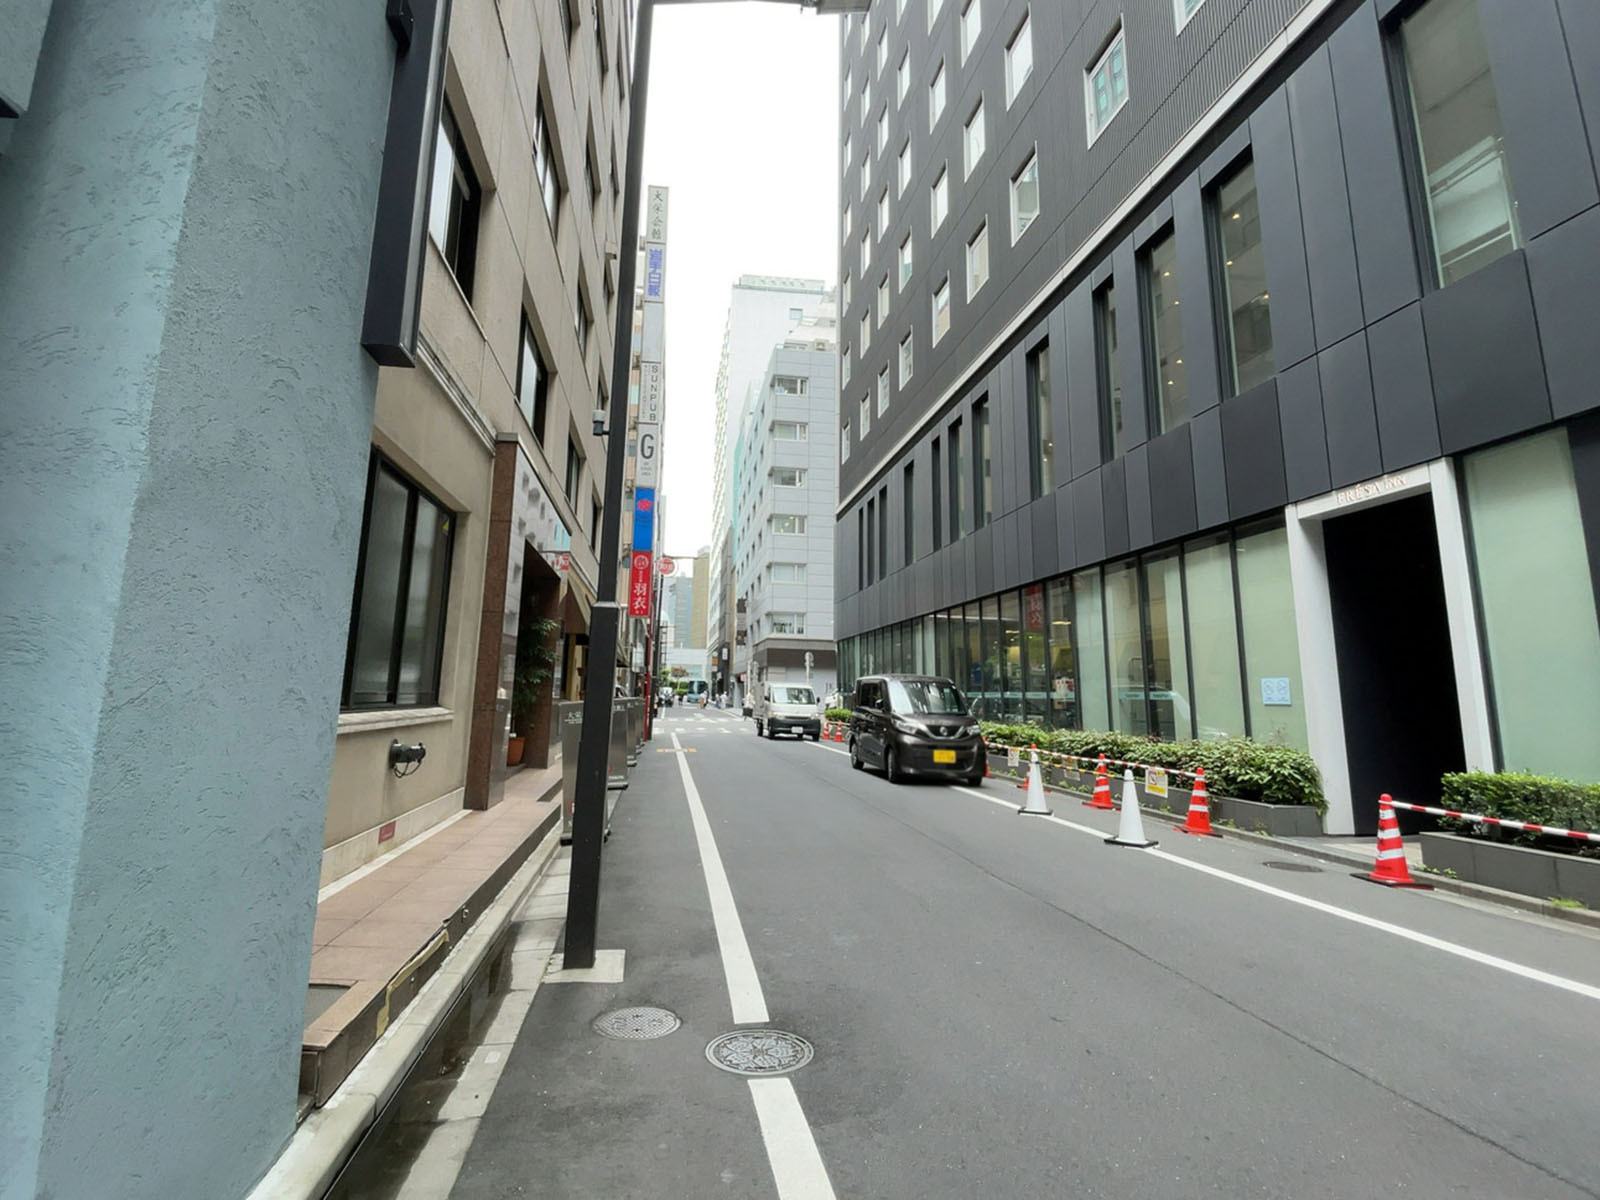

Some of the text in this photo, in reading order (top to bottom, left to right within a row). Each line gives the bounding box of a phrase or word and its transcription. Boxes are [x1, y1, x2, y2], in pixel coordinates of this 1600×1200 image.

[649, 364, 658, 421] SUNPUB
[640, 433, 655, 460] G
[633, 582, 648, 610] 羽衣
